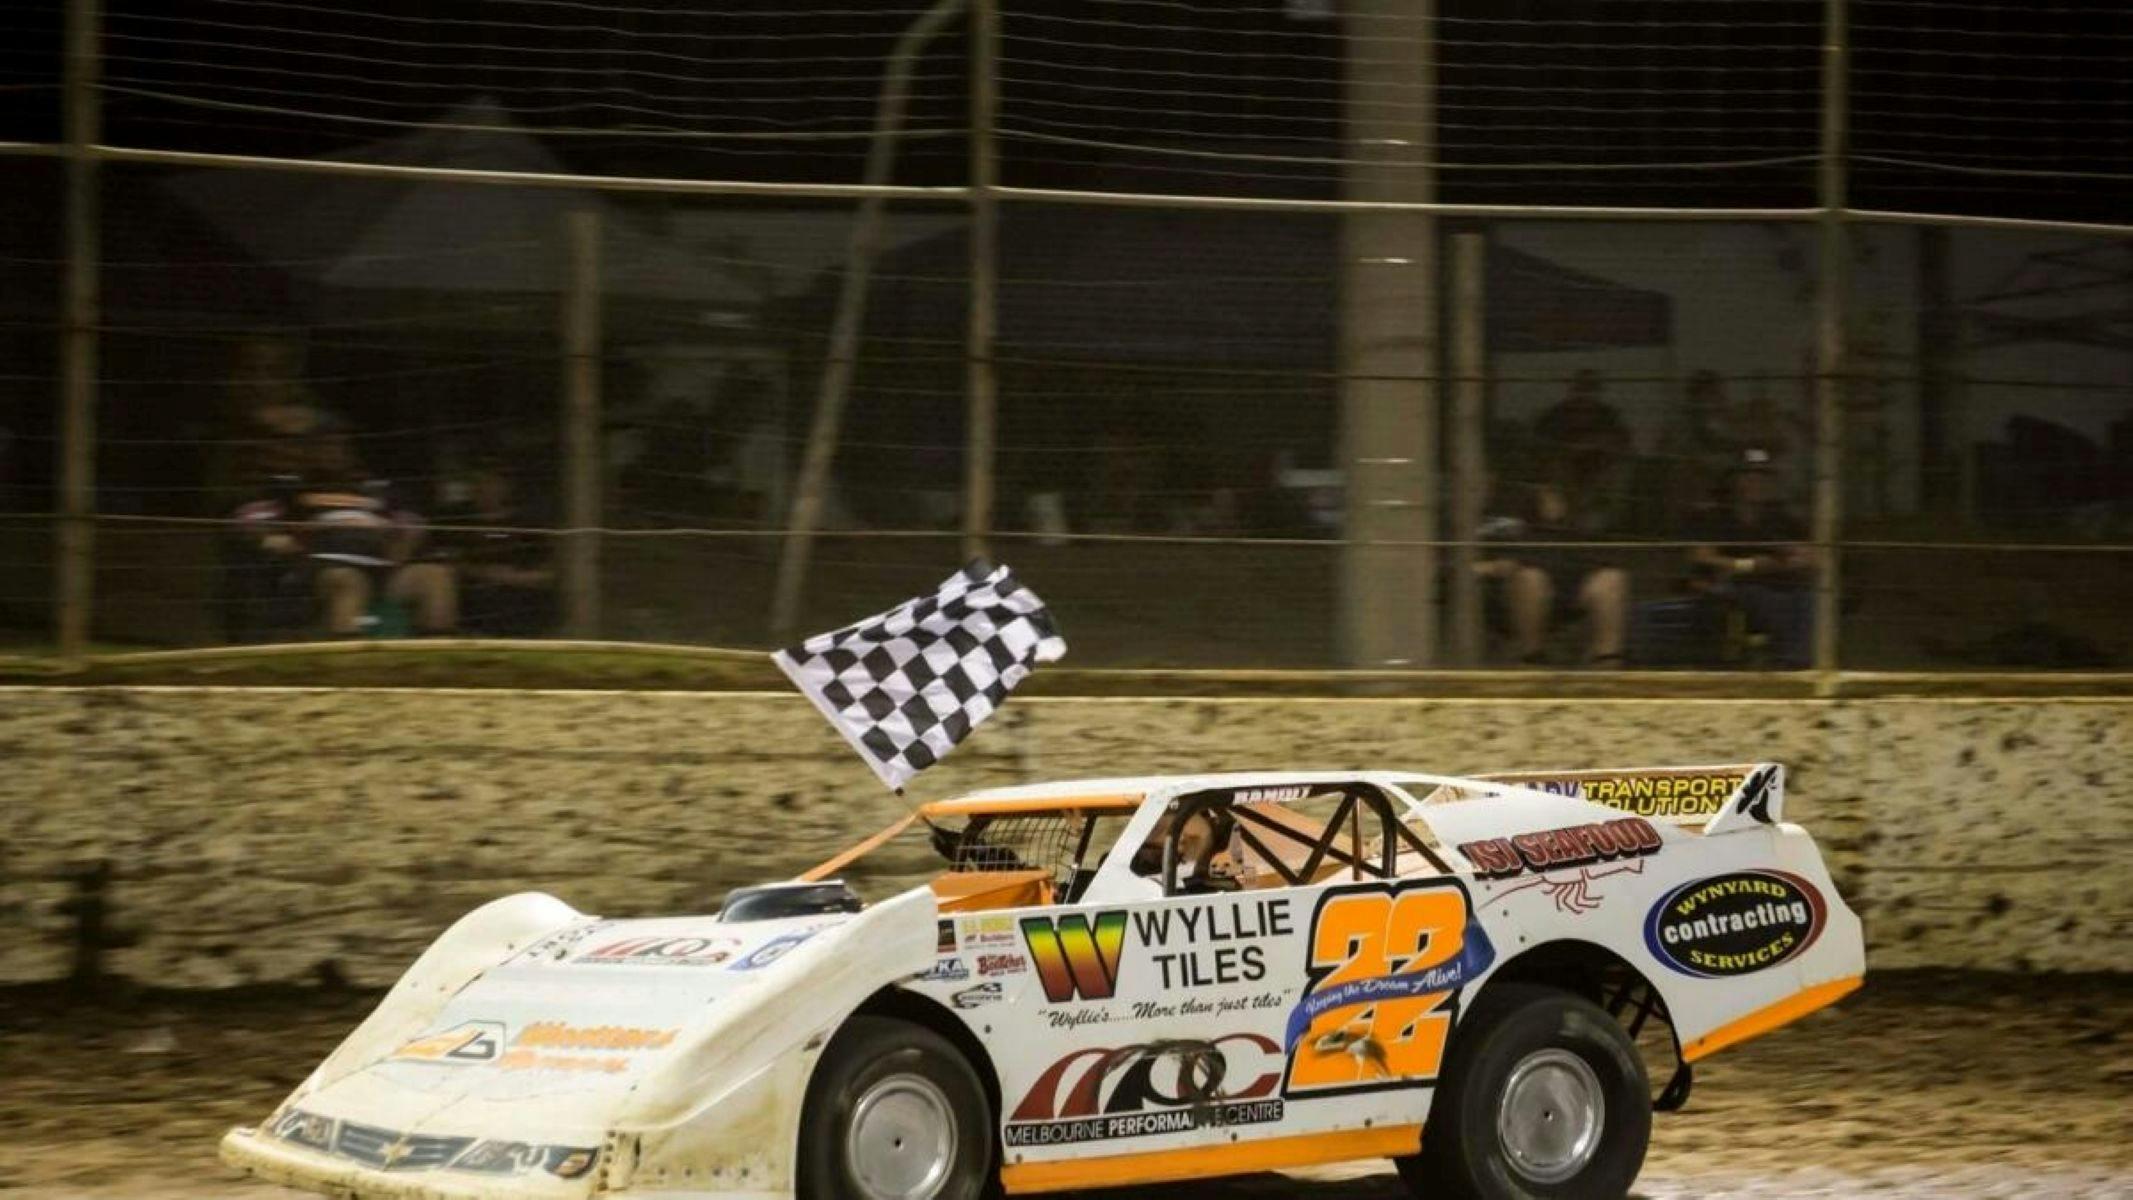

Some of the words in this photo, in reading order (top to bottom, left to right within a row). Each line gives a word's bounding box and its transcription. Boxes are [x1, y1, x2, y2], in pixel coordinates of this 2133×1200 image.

[1583, 777, 1744, 801] TRANSPORT
[1513, 817, 1663, 872] SEAFOOD
[1675, 880, 1787, 915] WYNYARD
[1133, 899, 1294, 947] WYLLIE
[1664, 902, 1808, 944] contracting
[1152, 945, 1266, 989] TILES
[1690, 931, 1795, 969] SERVICES
[1180, 998, 1213, 1015] than
[1217, 995, 1248, 1017] just
[1281, 876, 1474, 1100] 22
[1006, 1120, 1105, 1146] MELBOURNE
[1225, 1101, 1282, 1124] CENTRE
